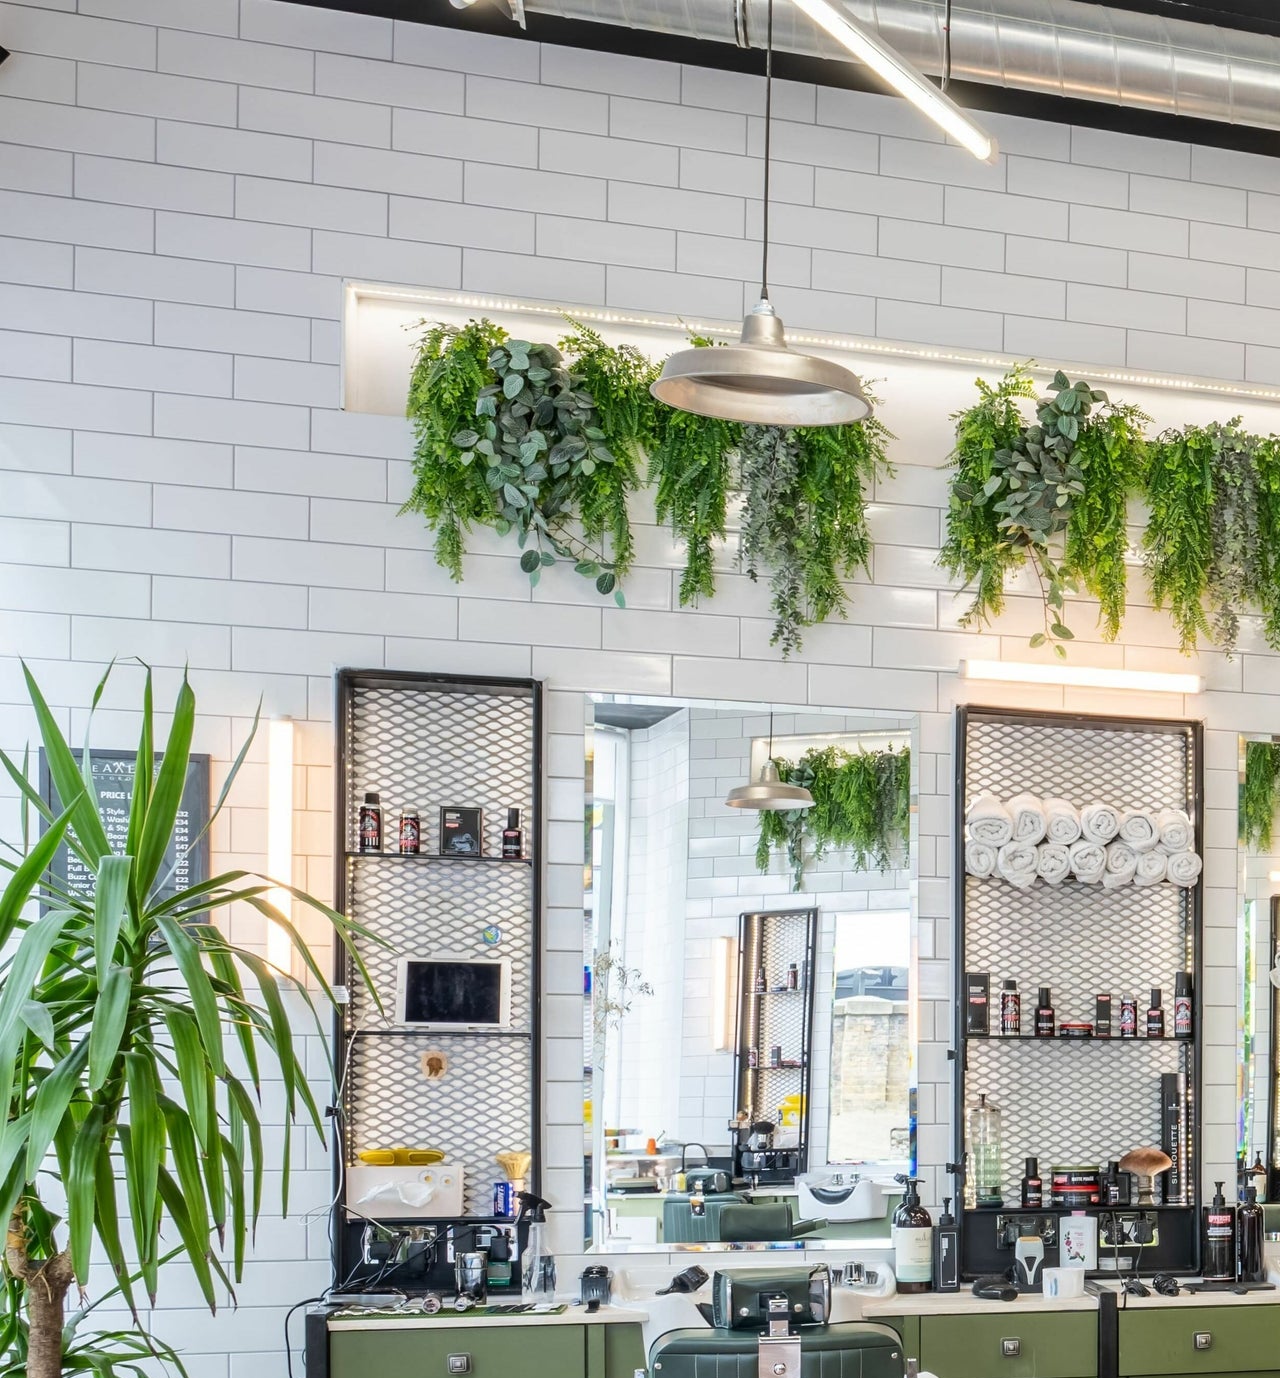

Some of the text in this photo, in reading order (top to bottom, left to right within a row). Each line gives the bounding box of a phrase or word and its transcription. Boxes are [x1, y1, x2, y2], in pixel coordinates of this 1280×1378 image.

[100, 791, 126, 800] PRICE
[106, 807, 126, 816] Style
[107, 832, 128, 840] Bear
